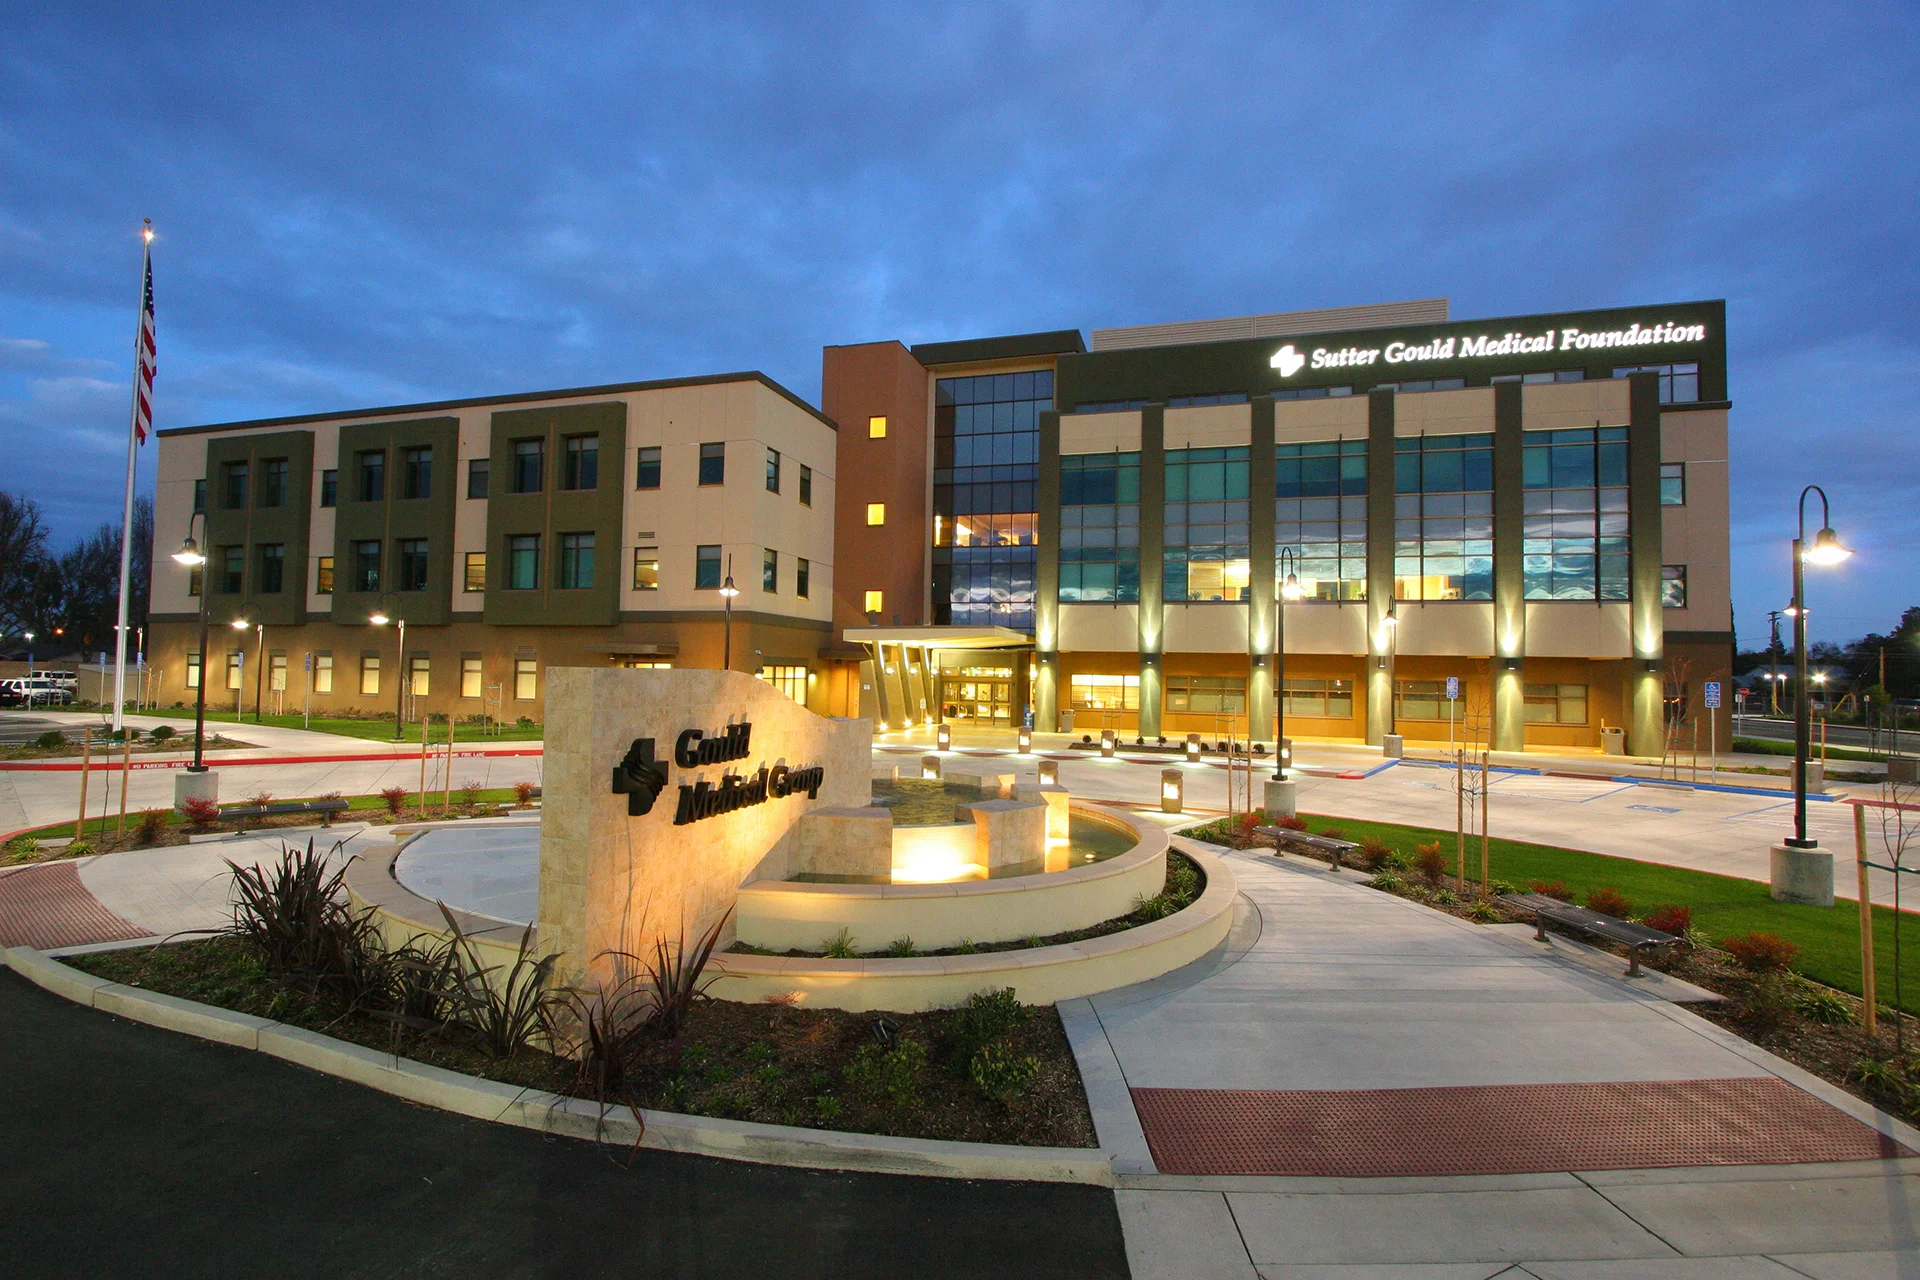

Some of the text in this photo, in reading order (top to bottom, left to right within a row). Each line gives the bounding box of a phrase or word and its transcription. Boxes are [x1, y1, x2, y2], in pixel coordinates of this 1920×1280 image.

[1311, 321, 1705, 369] Sutter Gould Medical Foundation
[675, 723, 751, 768] Gould
[673, 765, 824, 825] Medical Group
